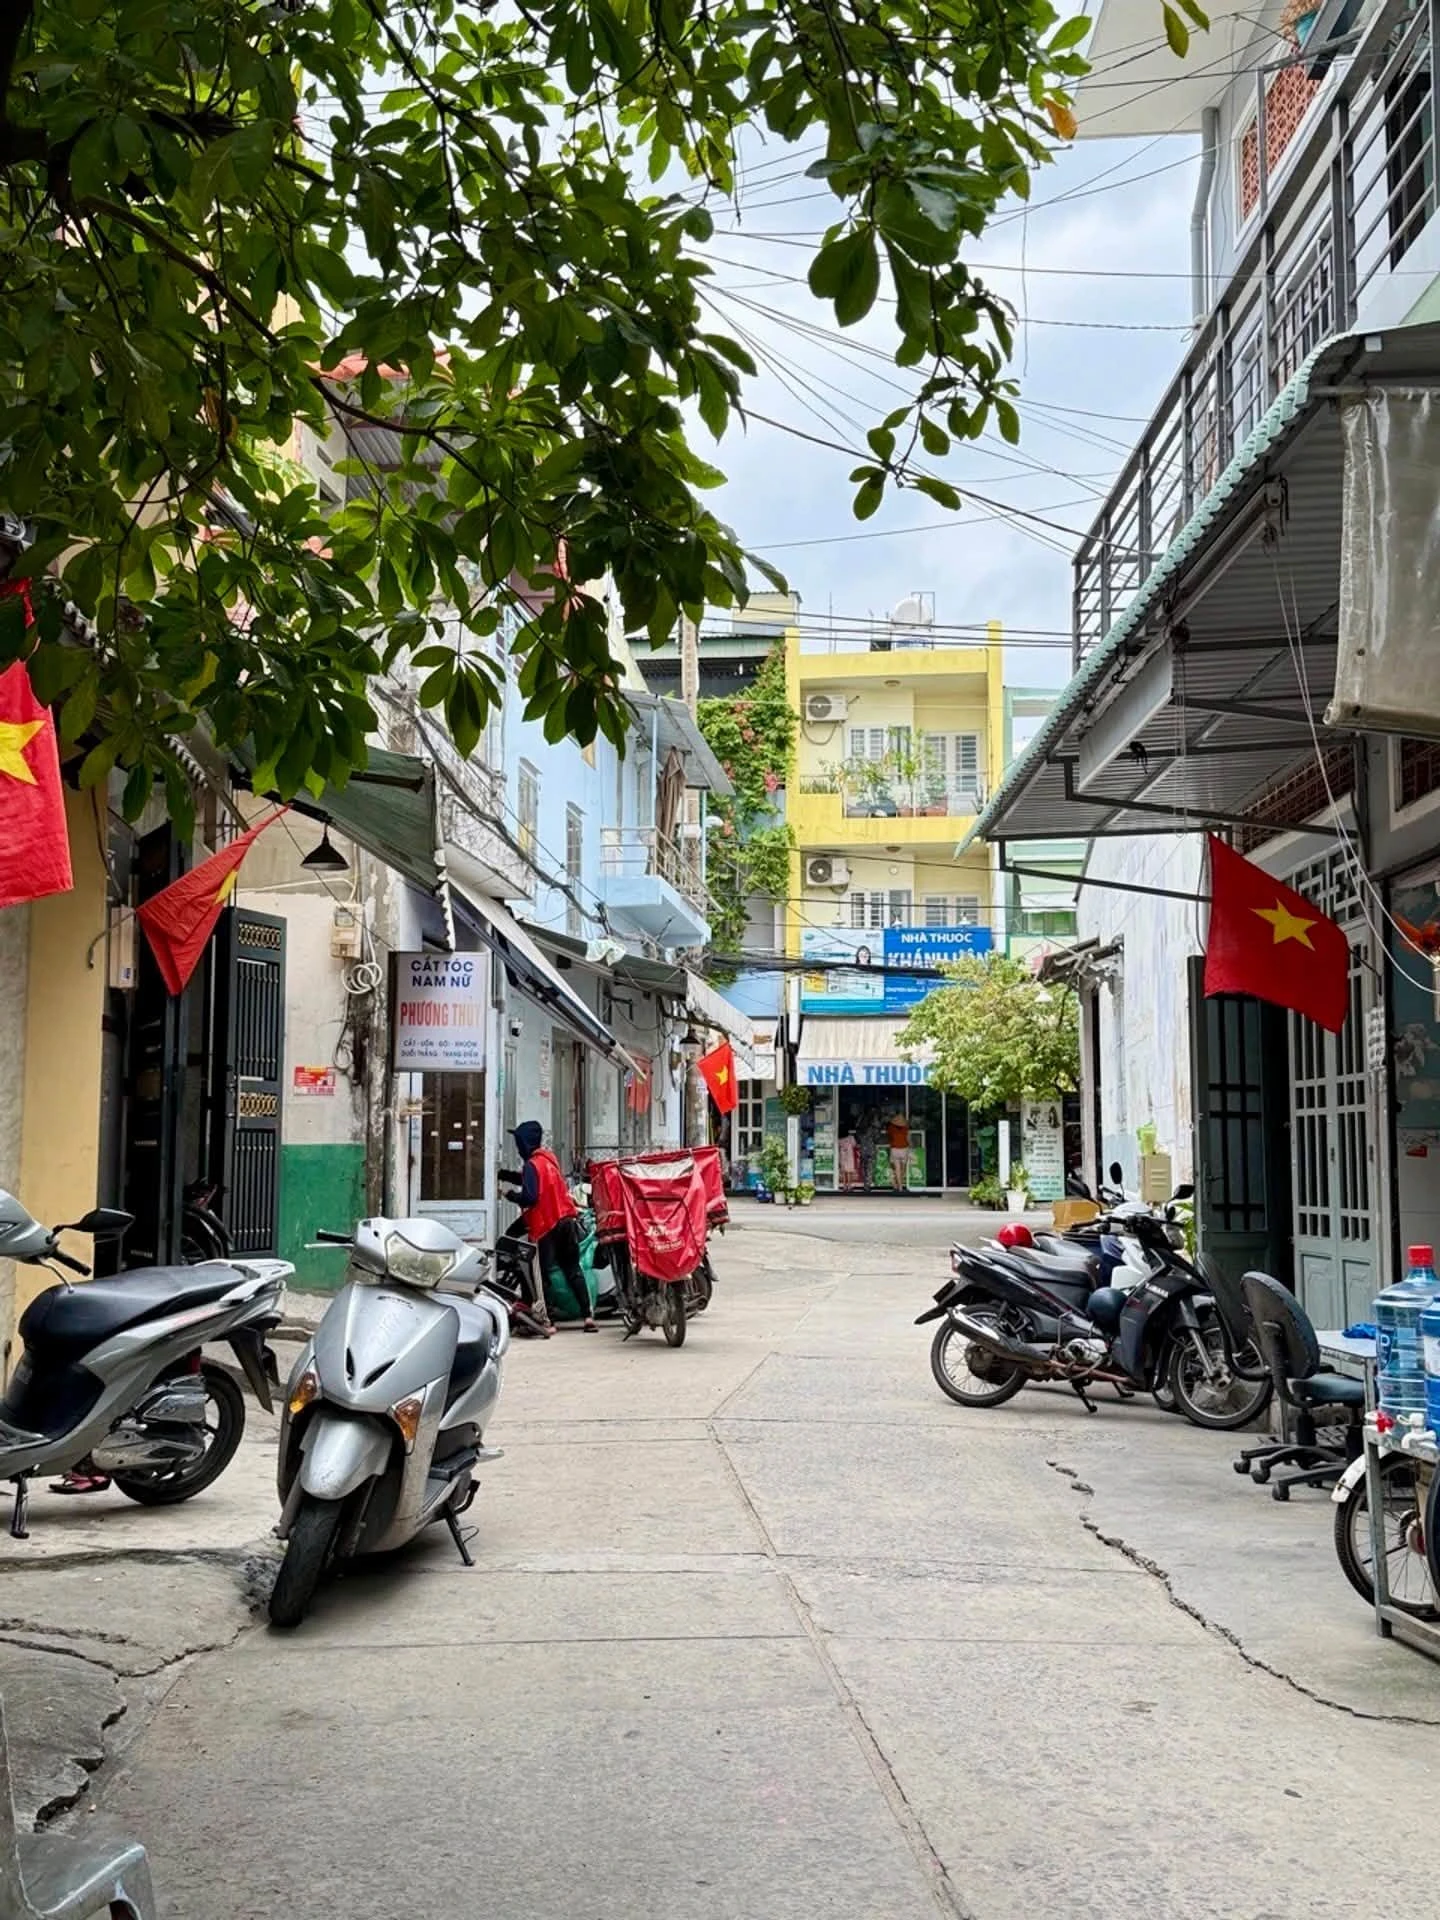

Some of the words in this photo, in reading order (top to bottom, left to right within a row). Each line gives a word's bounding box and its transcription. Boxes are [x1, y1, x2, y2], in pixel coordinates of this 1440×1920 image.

[901, 931, 928, 943] NHÀ
[411, 955, 441, 972] CẮT
[443, 957, 473, 972] TÓC
[412, 975, 446, 987] NAM
[450, 974, 472, 988] NỮ
[400, 1000, 449, 1027] PHƯƠNG
[807, 1062, 855, 1084] NHÀ
